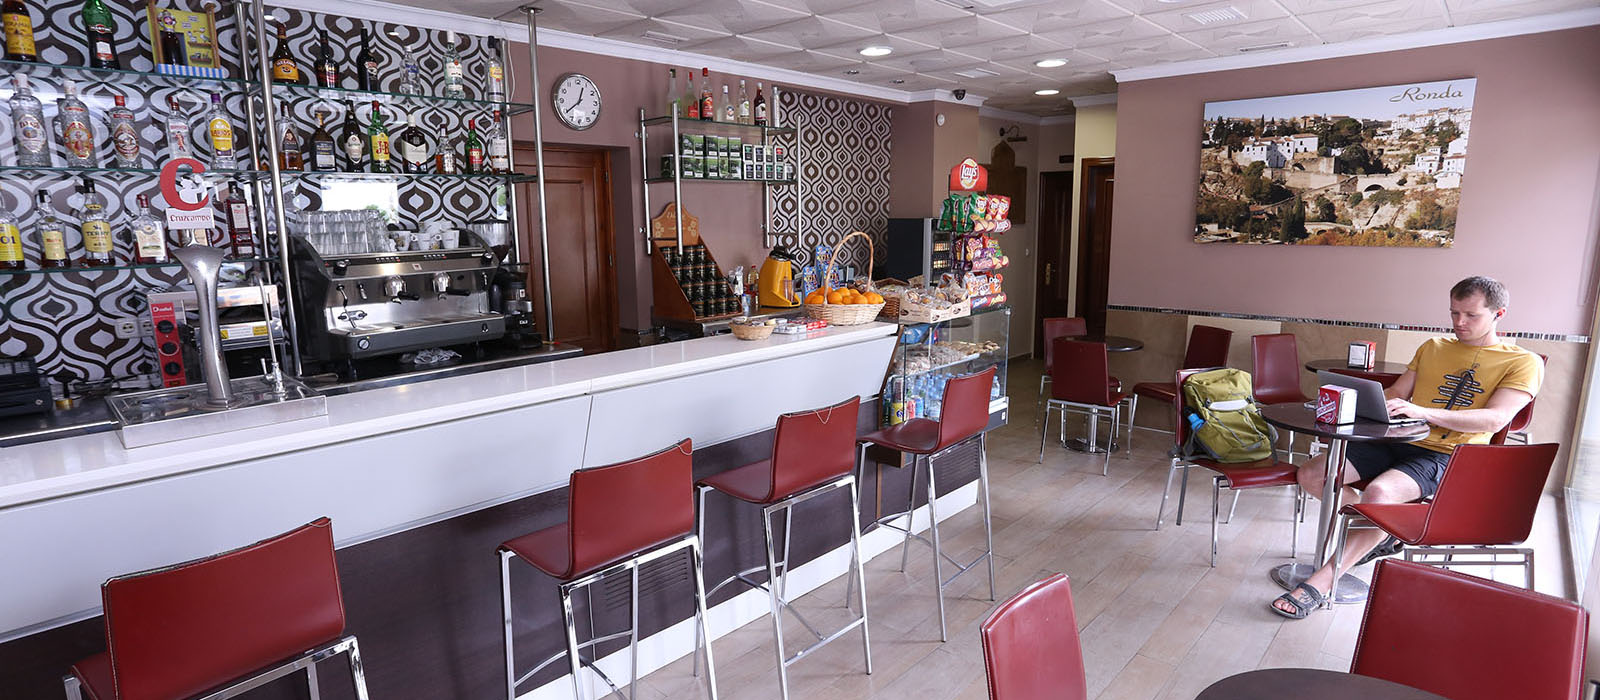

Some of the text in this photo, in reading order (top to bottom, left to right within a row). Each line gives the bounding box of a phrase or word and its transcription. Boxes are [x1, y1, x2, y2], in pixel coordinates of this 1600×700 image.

[1389, 84, 1464, 103] Ronda
[962, 165, 978, 182] Lay's
[170, 214, 211, 224] Cruzcampo
